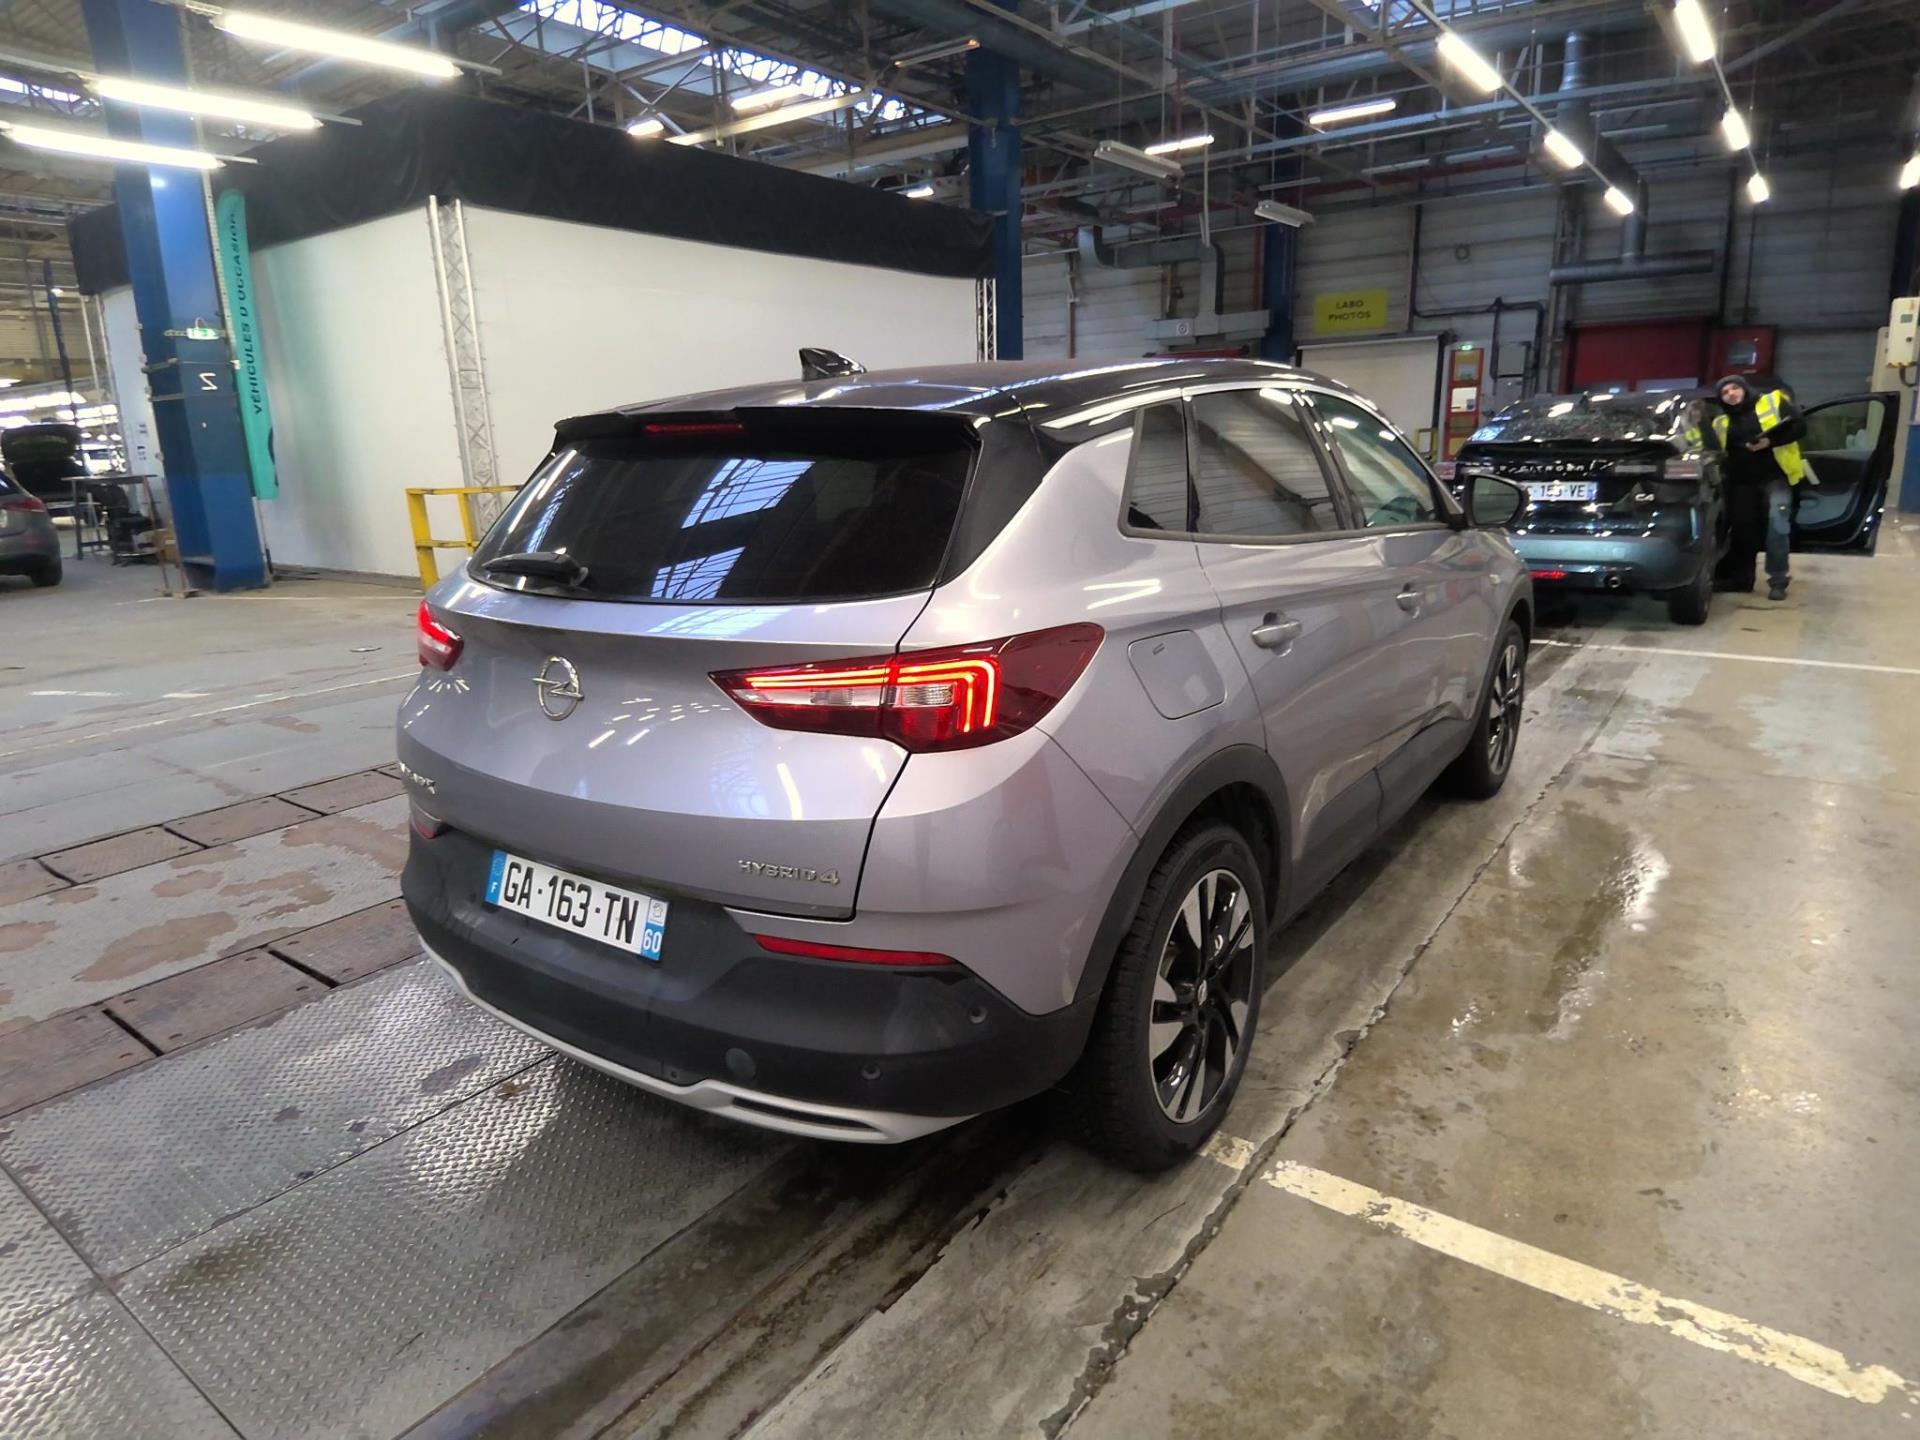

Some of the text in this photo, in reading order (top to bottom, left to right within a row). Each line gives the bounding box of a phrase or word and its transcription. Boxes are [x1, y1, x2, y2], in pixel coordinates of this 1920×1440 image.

[1335, 299, 1364, 310] LABO
[1328, 311, 1371, 321] PHOTOS
[491, 881, 498, 894] F
[643, 928, 663, 953] 60
